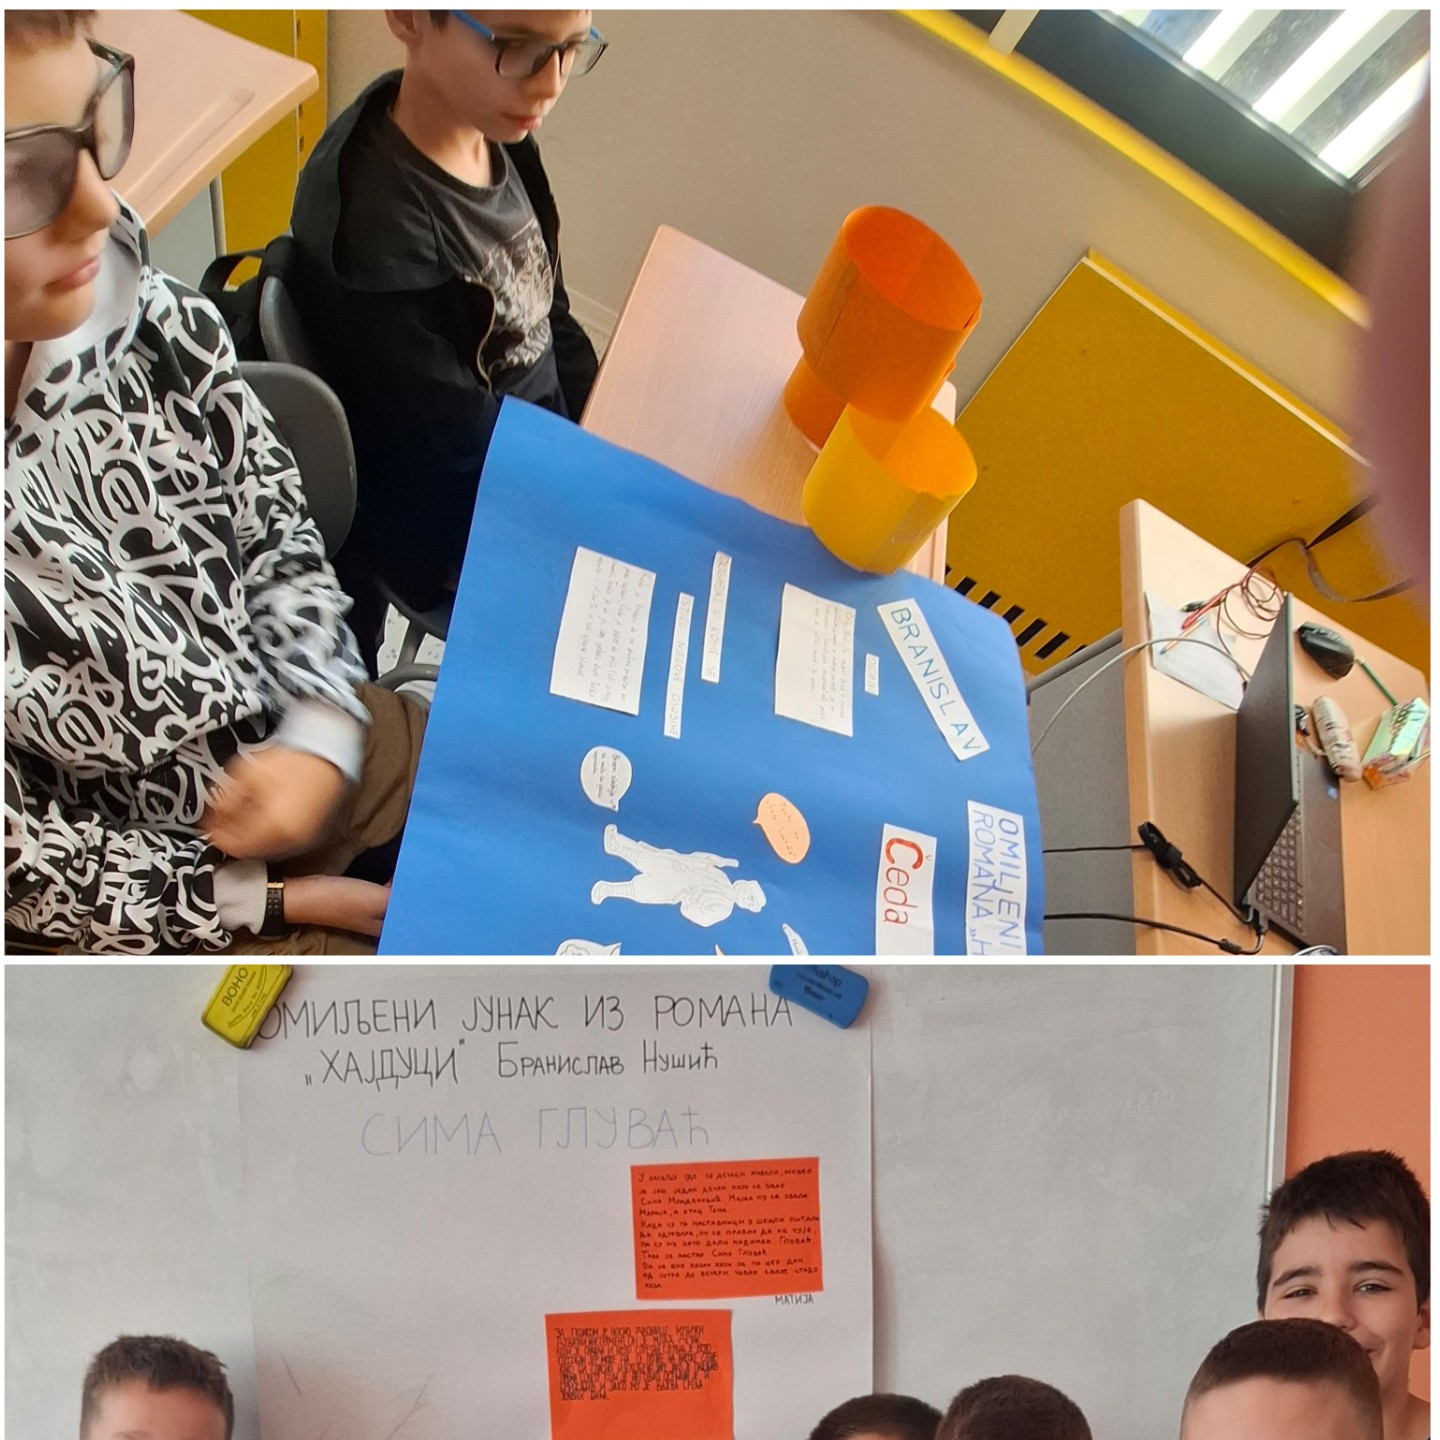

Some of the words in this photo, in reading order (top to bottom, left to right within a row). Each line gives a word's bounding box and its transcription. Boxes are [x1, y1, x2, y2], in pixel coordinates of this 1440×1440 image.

[891, 607, 981, 750] BRANISLAV
[669, 694, 681, 737] OSOBINE
[883, 838, 932, 925] Čeda
[972, 810, 997, 919] ROMANA
[222, 966, 249, 1007] BOHO
[258, 999, 436, 1040] ОМИЉЕНИ
[462, 996, 559, 1033] ЈУНАК
[585, 995, 625, 1030] ИЗ
[654, 993, 793, 1030] РОМАНА
[499, 1041, 625, 1079] Бранислав
[643, 1039, 718, 1073] Нушић
[362, 1112, 502, 1156] СИМА
[538, 1106, 709, 1149] ГЛУВАЋ
[775, 1294, 814, 1305] МАТИЈА
